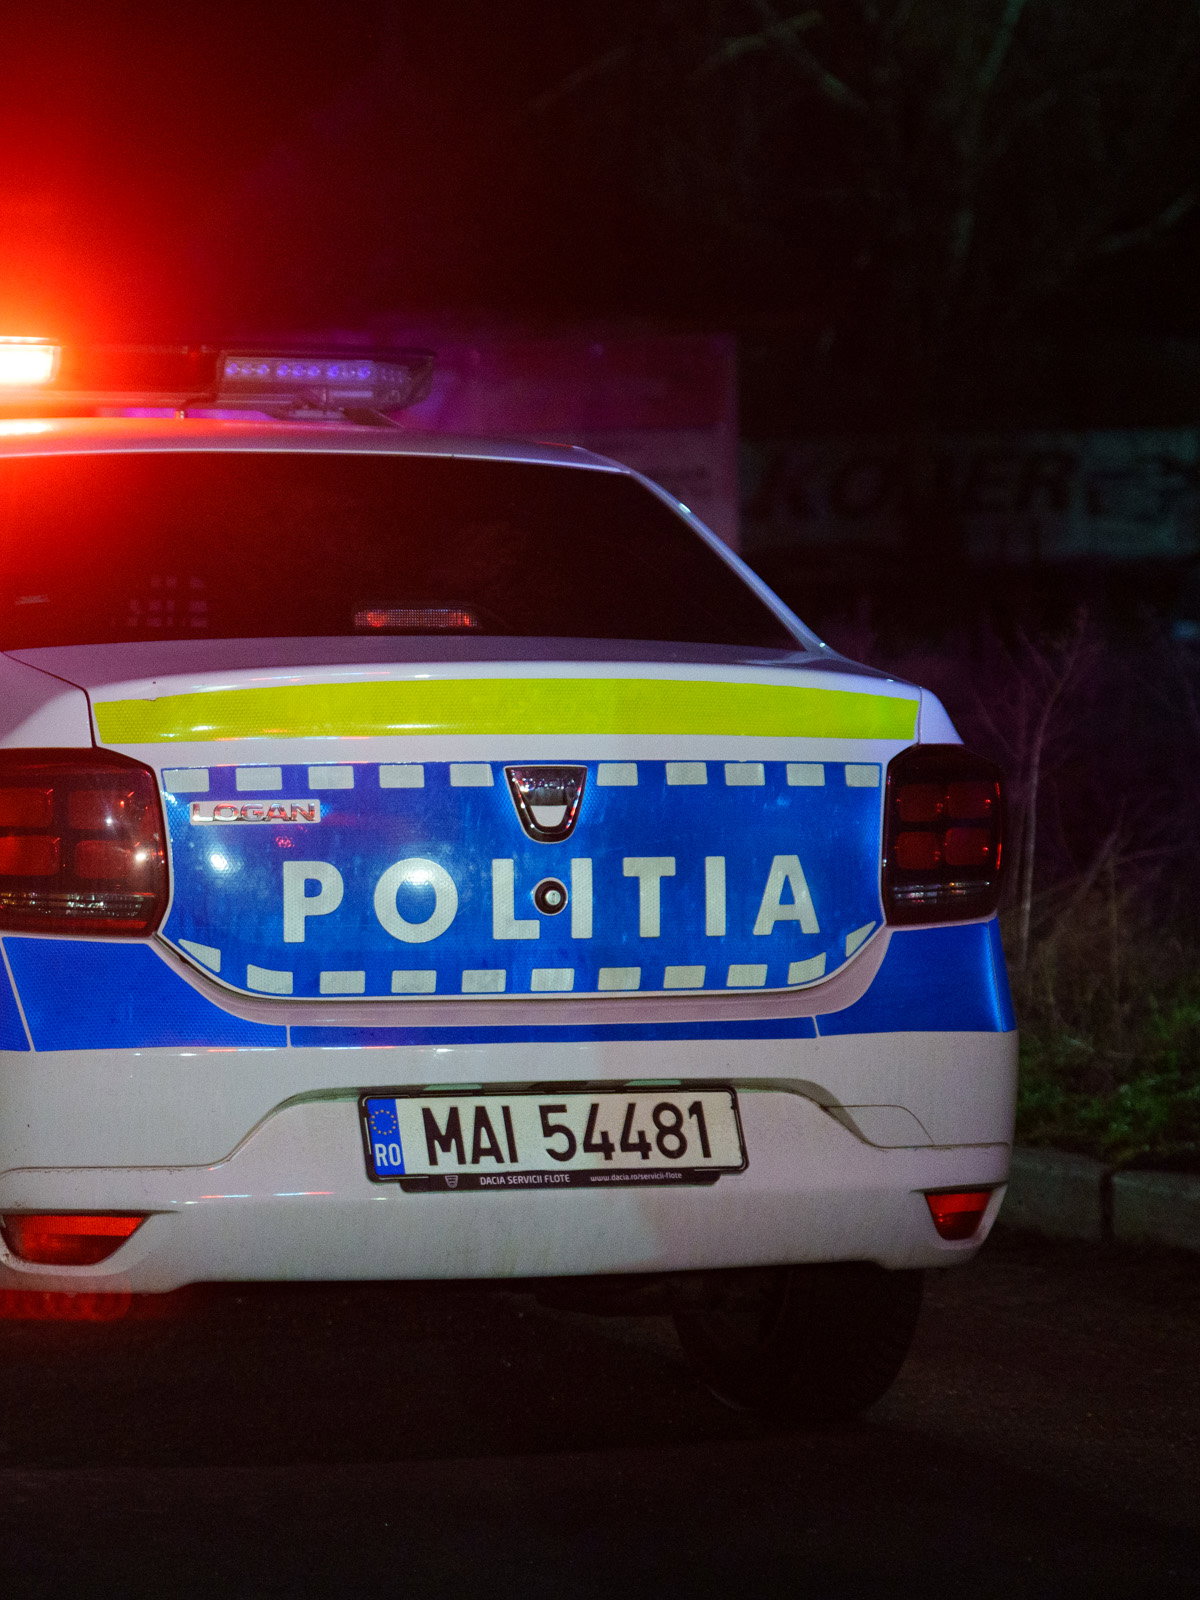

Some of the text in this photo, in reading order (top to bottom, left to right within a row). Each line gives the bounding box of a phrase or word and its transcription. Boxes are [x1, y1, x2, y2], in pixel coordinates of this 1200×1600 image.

[746, 450, 1077, 519] KOER
[192, 803, 316, 822] LOGAN
[282, 854, 821, 944] POLITIA
[421, 1100, 712, 1166] MAI 54481
[374, 1143, 402, 1167] RO
[480, 1174, 571, 1186] DACIA SERVICII FLOTE
[590, 1171, 683, 1182] www.dacia.ro/servicii-flote
